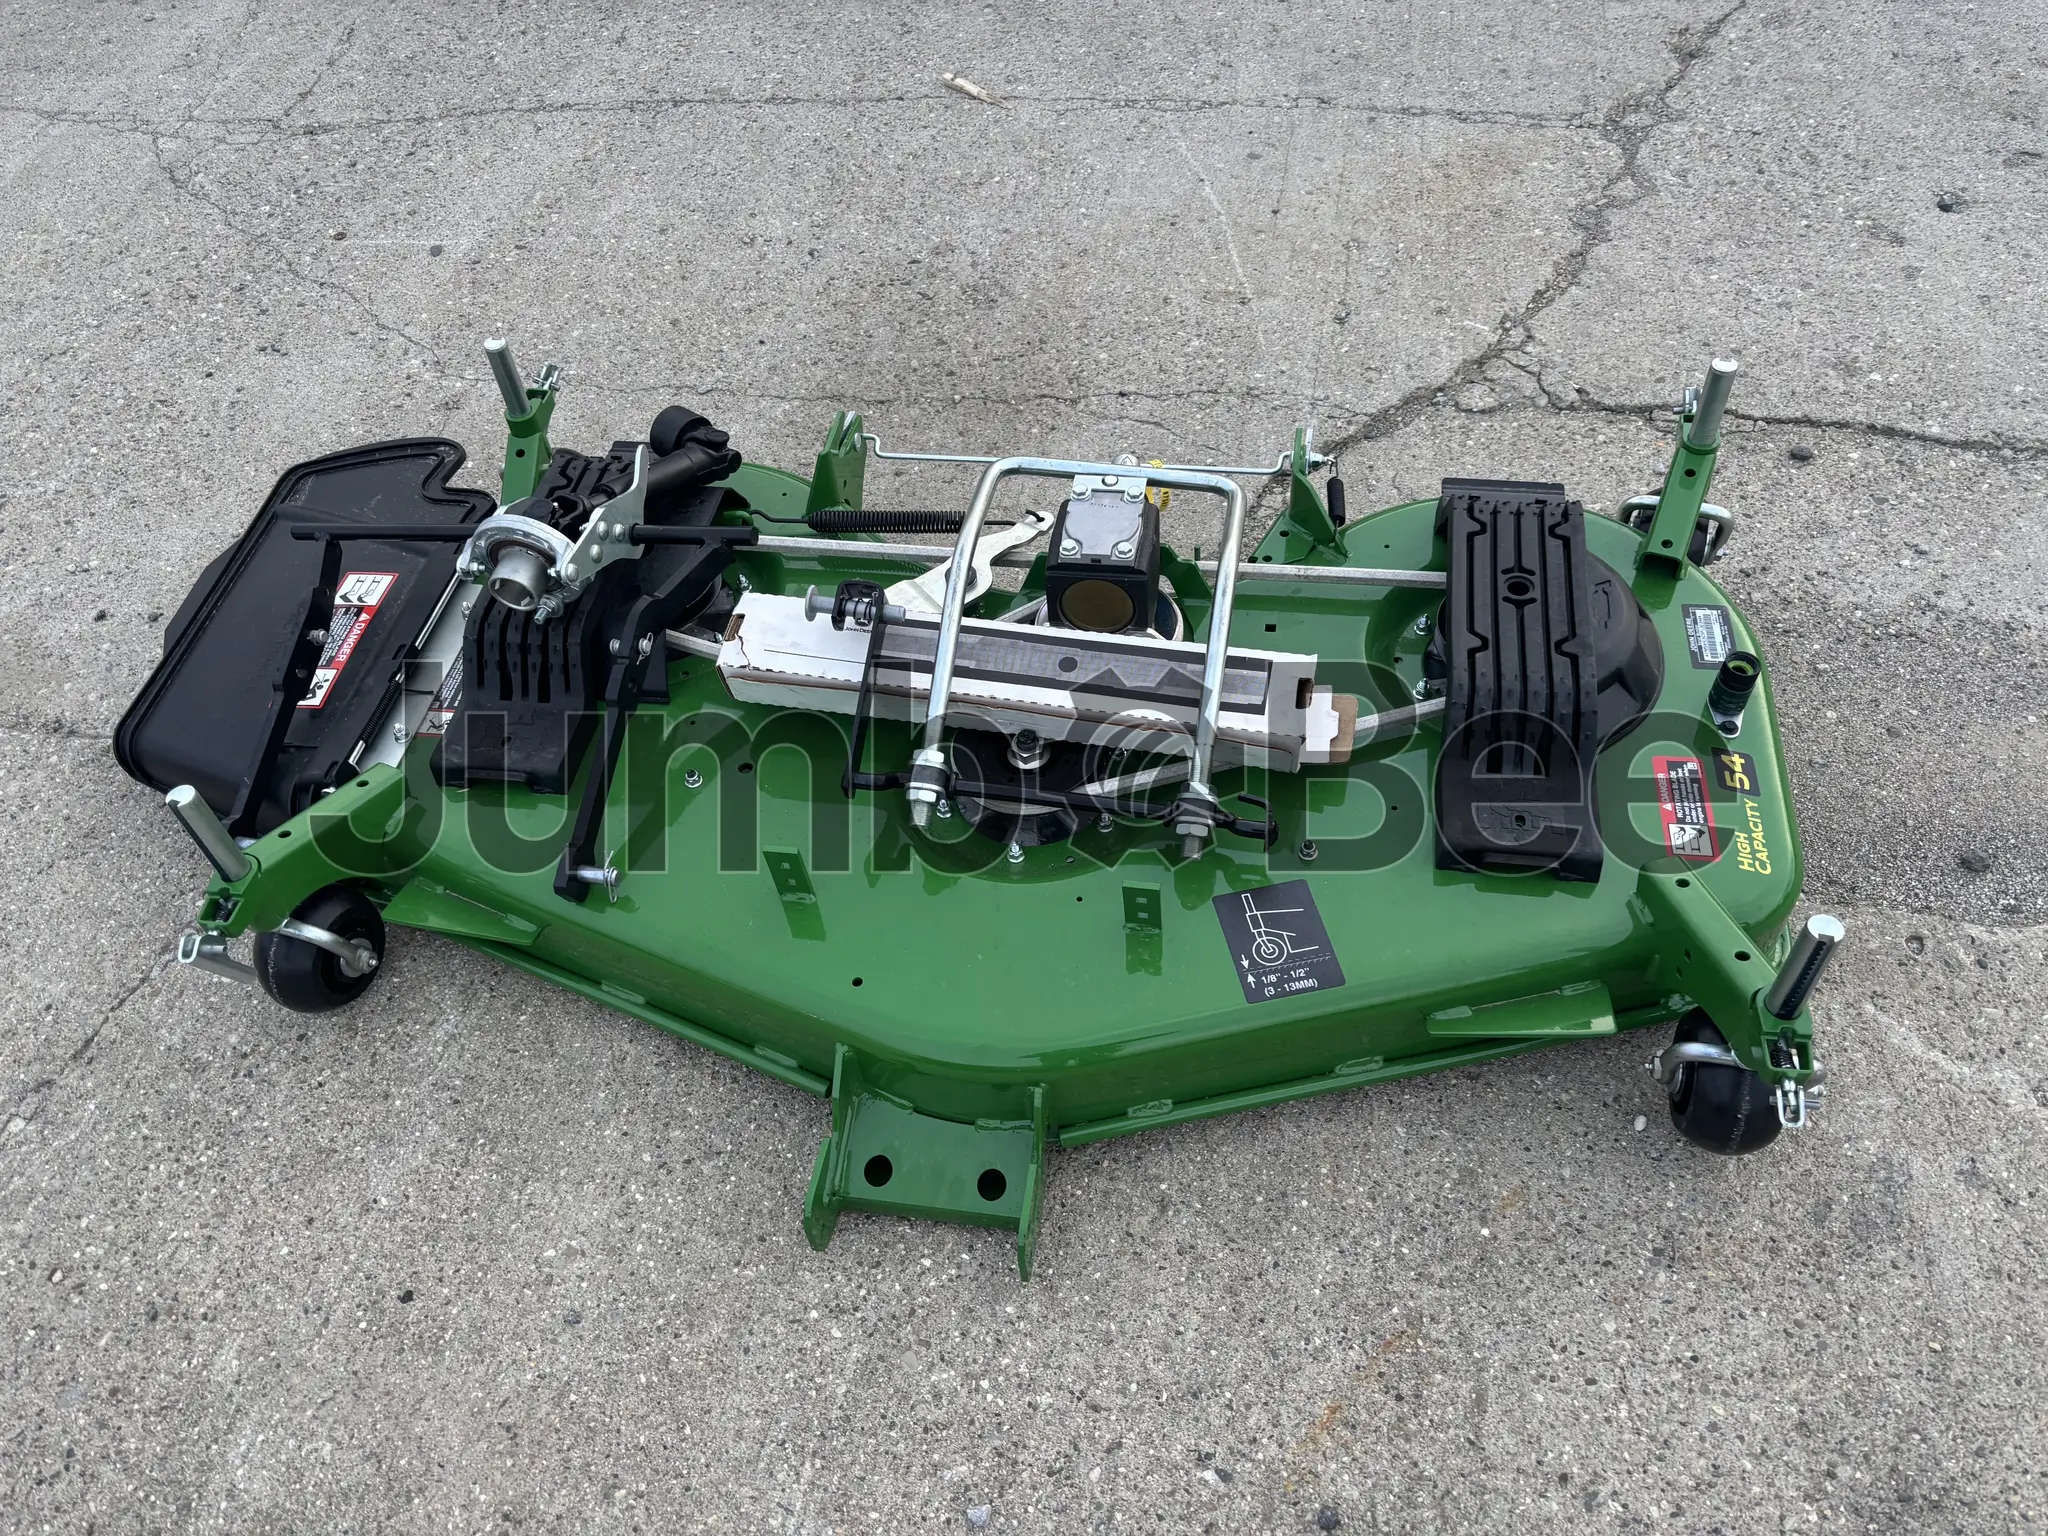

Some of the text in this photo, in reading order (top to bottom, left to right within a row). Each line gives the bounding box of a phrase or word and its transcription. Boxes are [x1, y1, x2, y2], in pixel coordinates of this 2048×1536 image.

[336, 622, 366, 662] DANGER
[1684, 617, 1698, 652] JOHN DEERE
[1657, 773, 1670, 803] DANGER
[1720, 753, 1750, 791] 54
[1669, 770, 1684, 818] ROTATING BLADE
[1696, 807, 1705, 824] engine
[1734, 831, 1756, 873] HIGH
[1743, 798, 1772, 876] CAPACITY
[1264, 986, 1276, 998] (3
[1283, 978, 1319, 993] 13MM)
